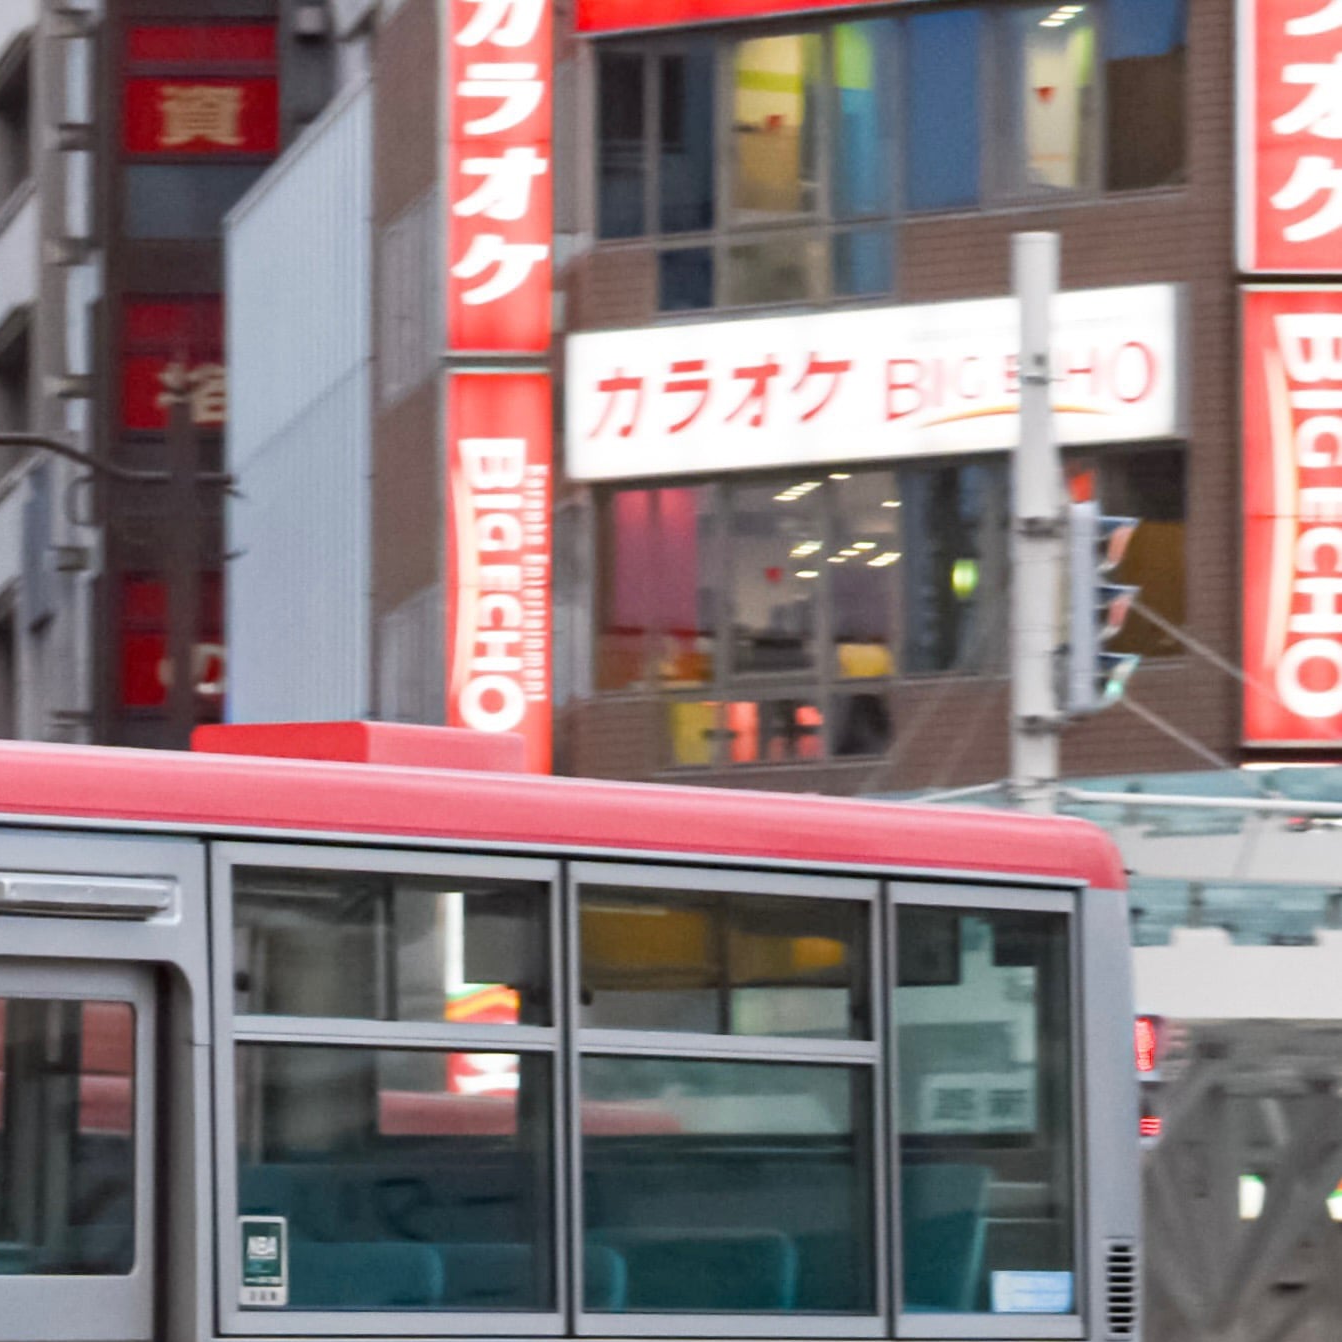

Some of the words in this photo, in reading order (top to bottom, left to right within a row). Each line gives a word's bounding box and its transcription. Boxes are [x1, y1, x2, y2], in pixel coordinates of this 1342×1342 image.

[588, 350, 853, 439] カラオケ
[884, 356, 983, 421] BIG
[1004, 341, 1159, 404] EHO
